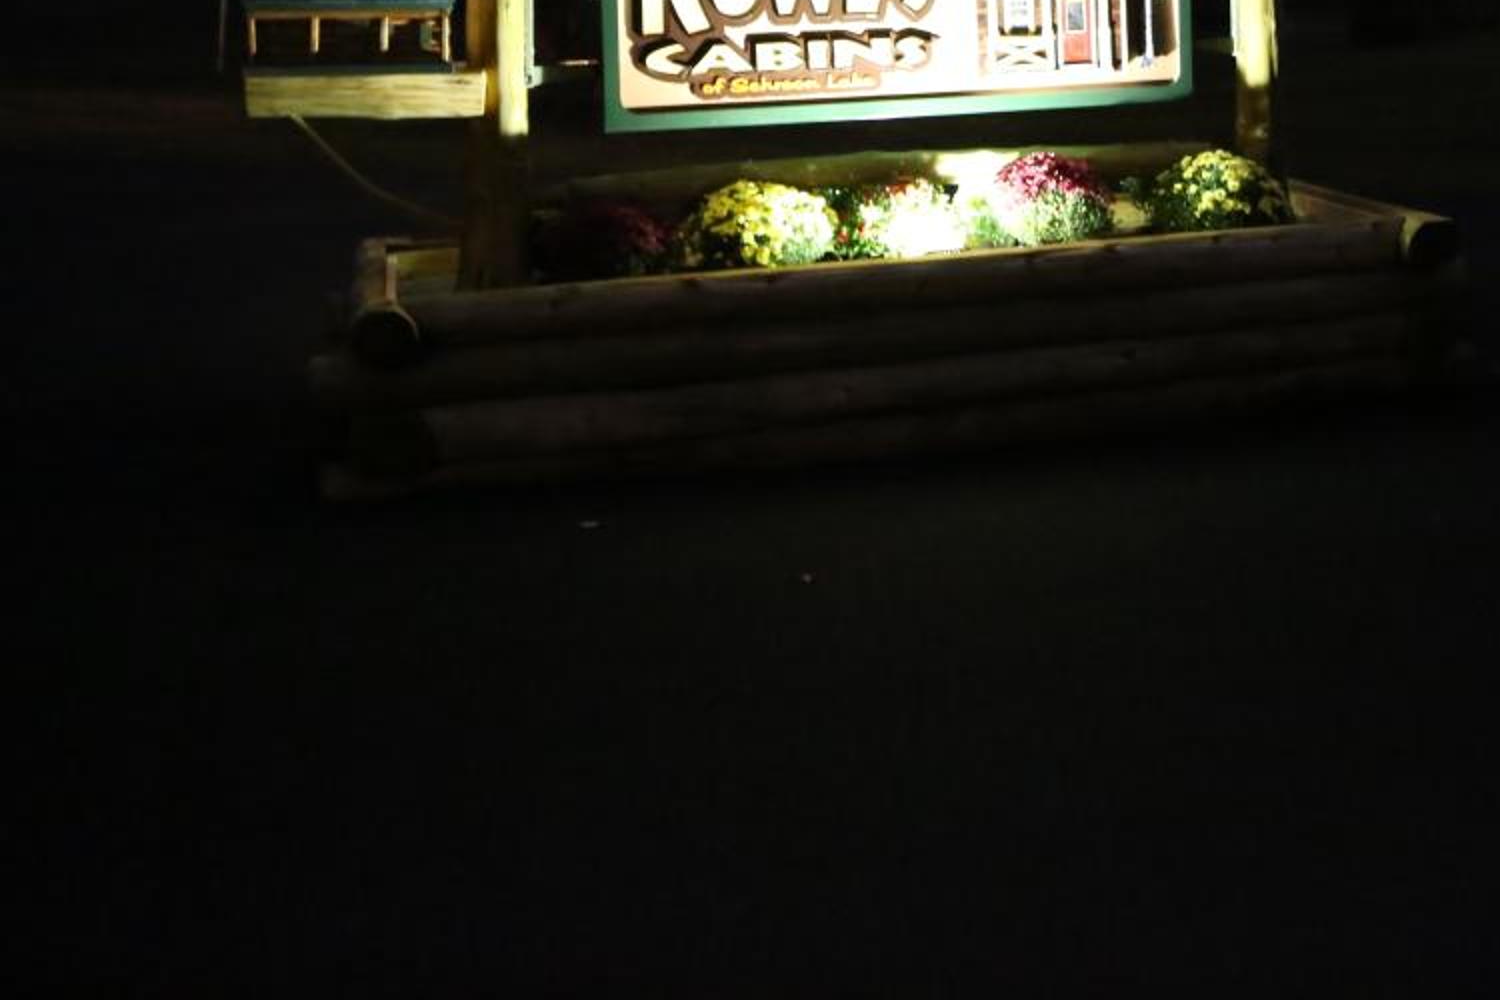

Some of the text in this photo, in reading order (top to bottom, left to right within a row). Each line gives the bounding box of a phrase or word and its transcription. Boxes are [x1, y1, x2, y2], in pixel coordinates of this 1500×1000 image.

[642, 33, 930, 78] CABINS
[702, 77, 727, 96] of
[827, 70, 877, 89] Lake
